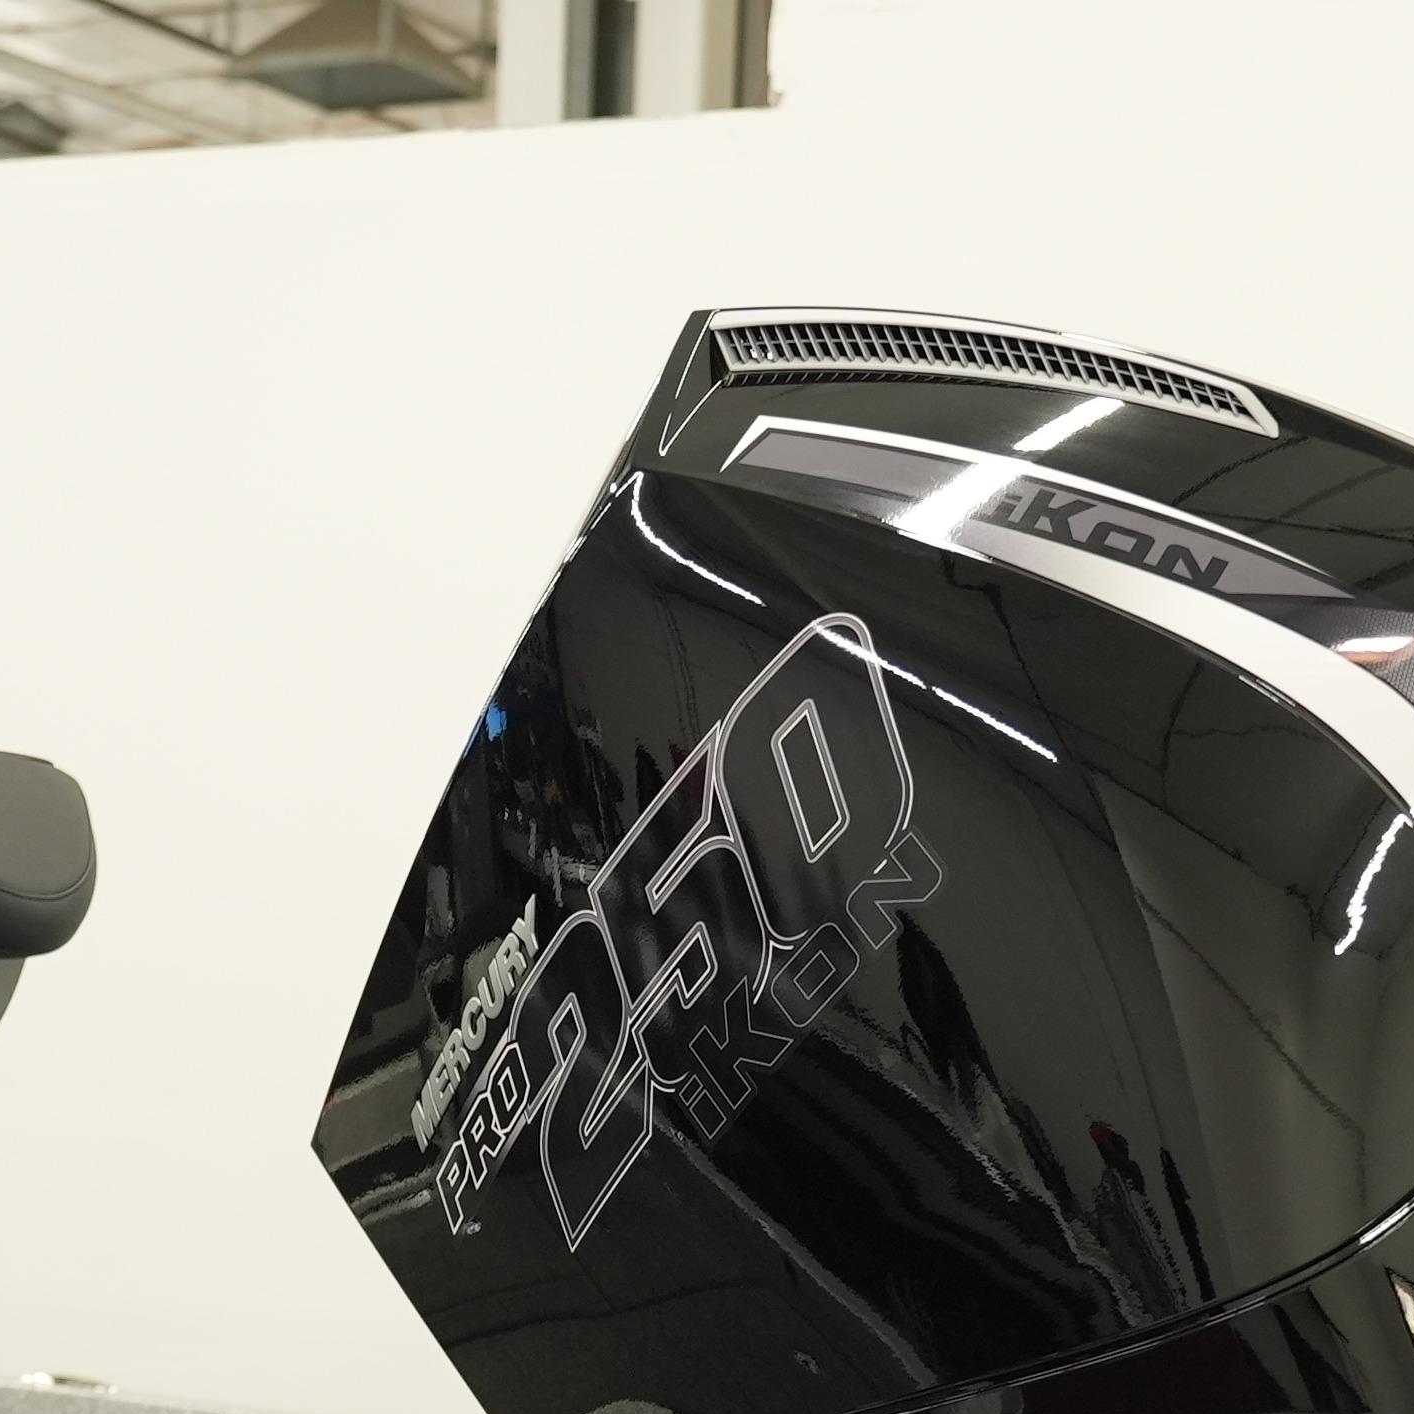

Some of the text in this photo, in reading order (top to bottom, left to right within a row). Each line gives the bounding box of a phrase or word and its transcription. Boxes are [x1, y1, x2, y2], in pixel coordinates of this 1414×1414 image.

[411, 893, 539, 1154] MERCURY
[435, 611, 914, 1253] PRO 250
